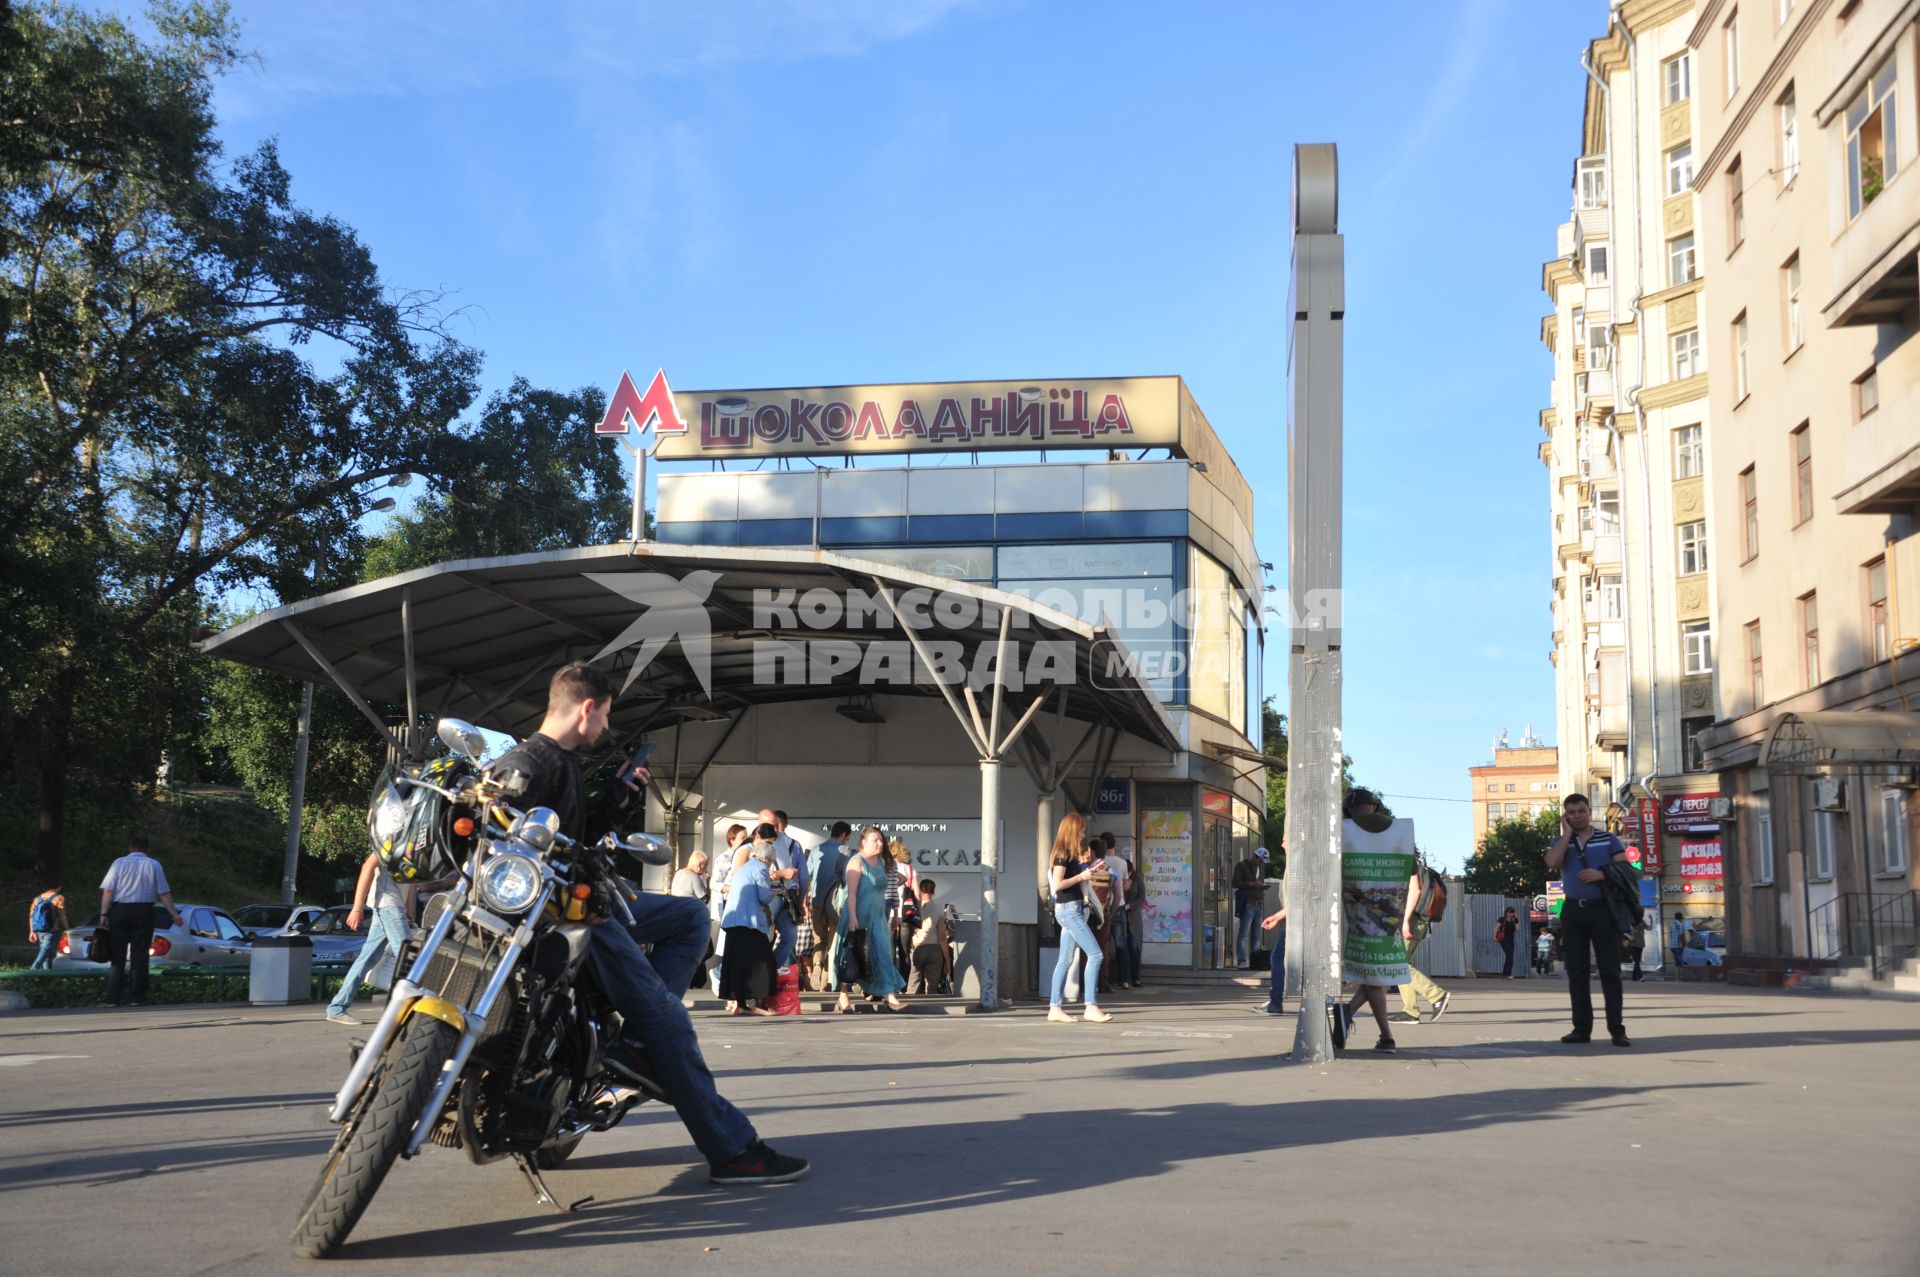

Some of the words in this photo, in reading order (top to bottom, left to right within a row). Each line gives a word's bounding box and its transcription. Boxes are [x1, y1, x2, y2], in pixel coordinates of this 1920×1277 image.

[595, 368, 687, 433] М
[699, 388, 1132, 449] ШОКОЛАДНИЦА
[1643, 813, 1658, 864] ЦВЕТЫ
[1681, 843, 1722, 859] АРЕНДА
[1344, 868, 1382, 877] ОПТОВЫЕ
[1376, 858, 1406, 867] НИЗКИЕ
